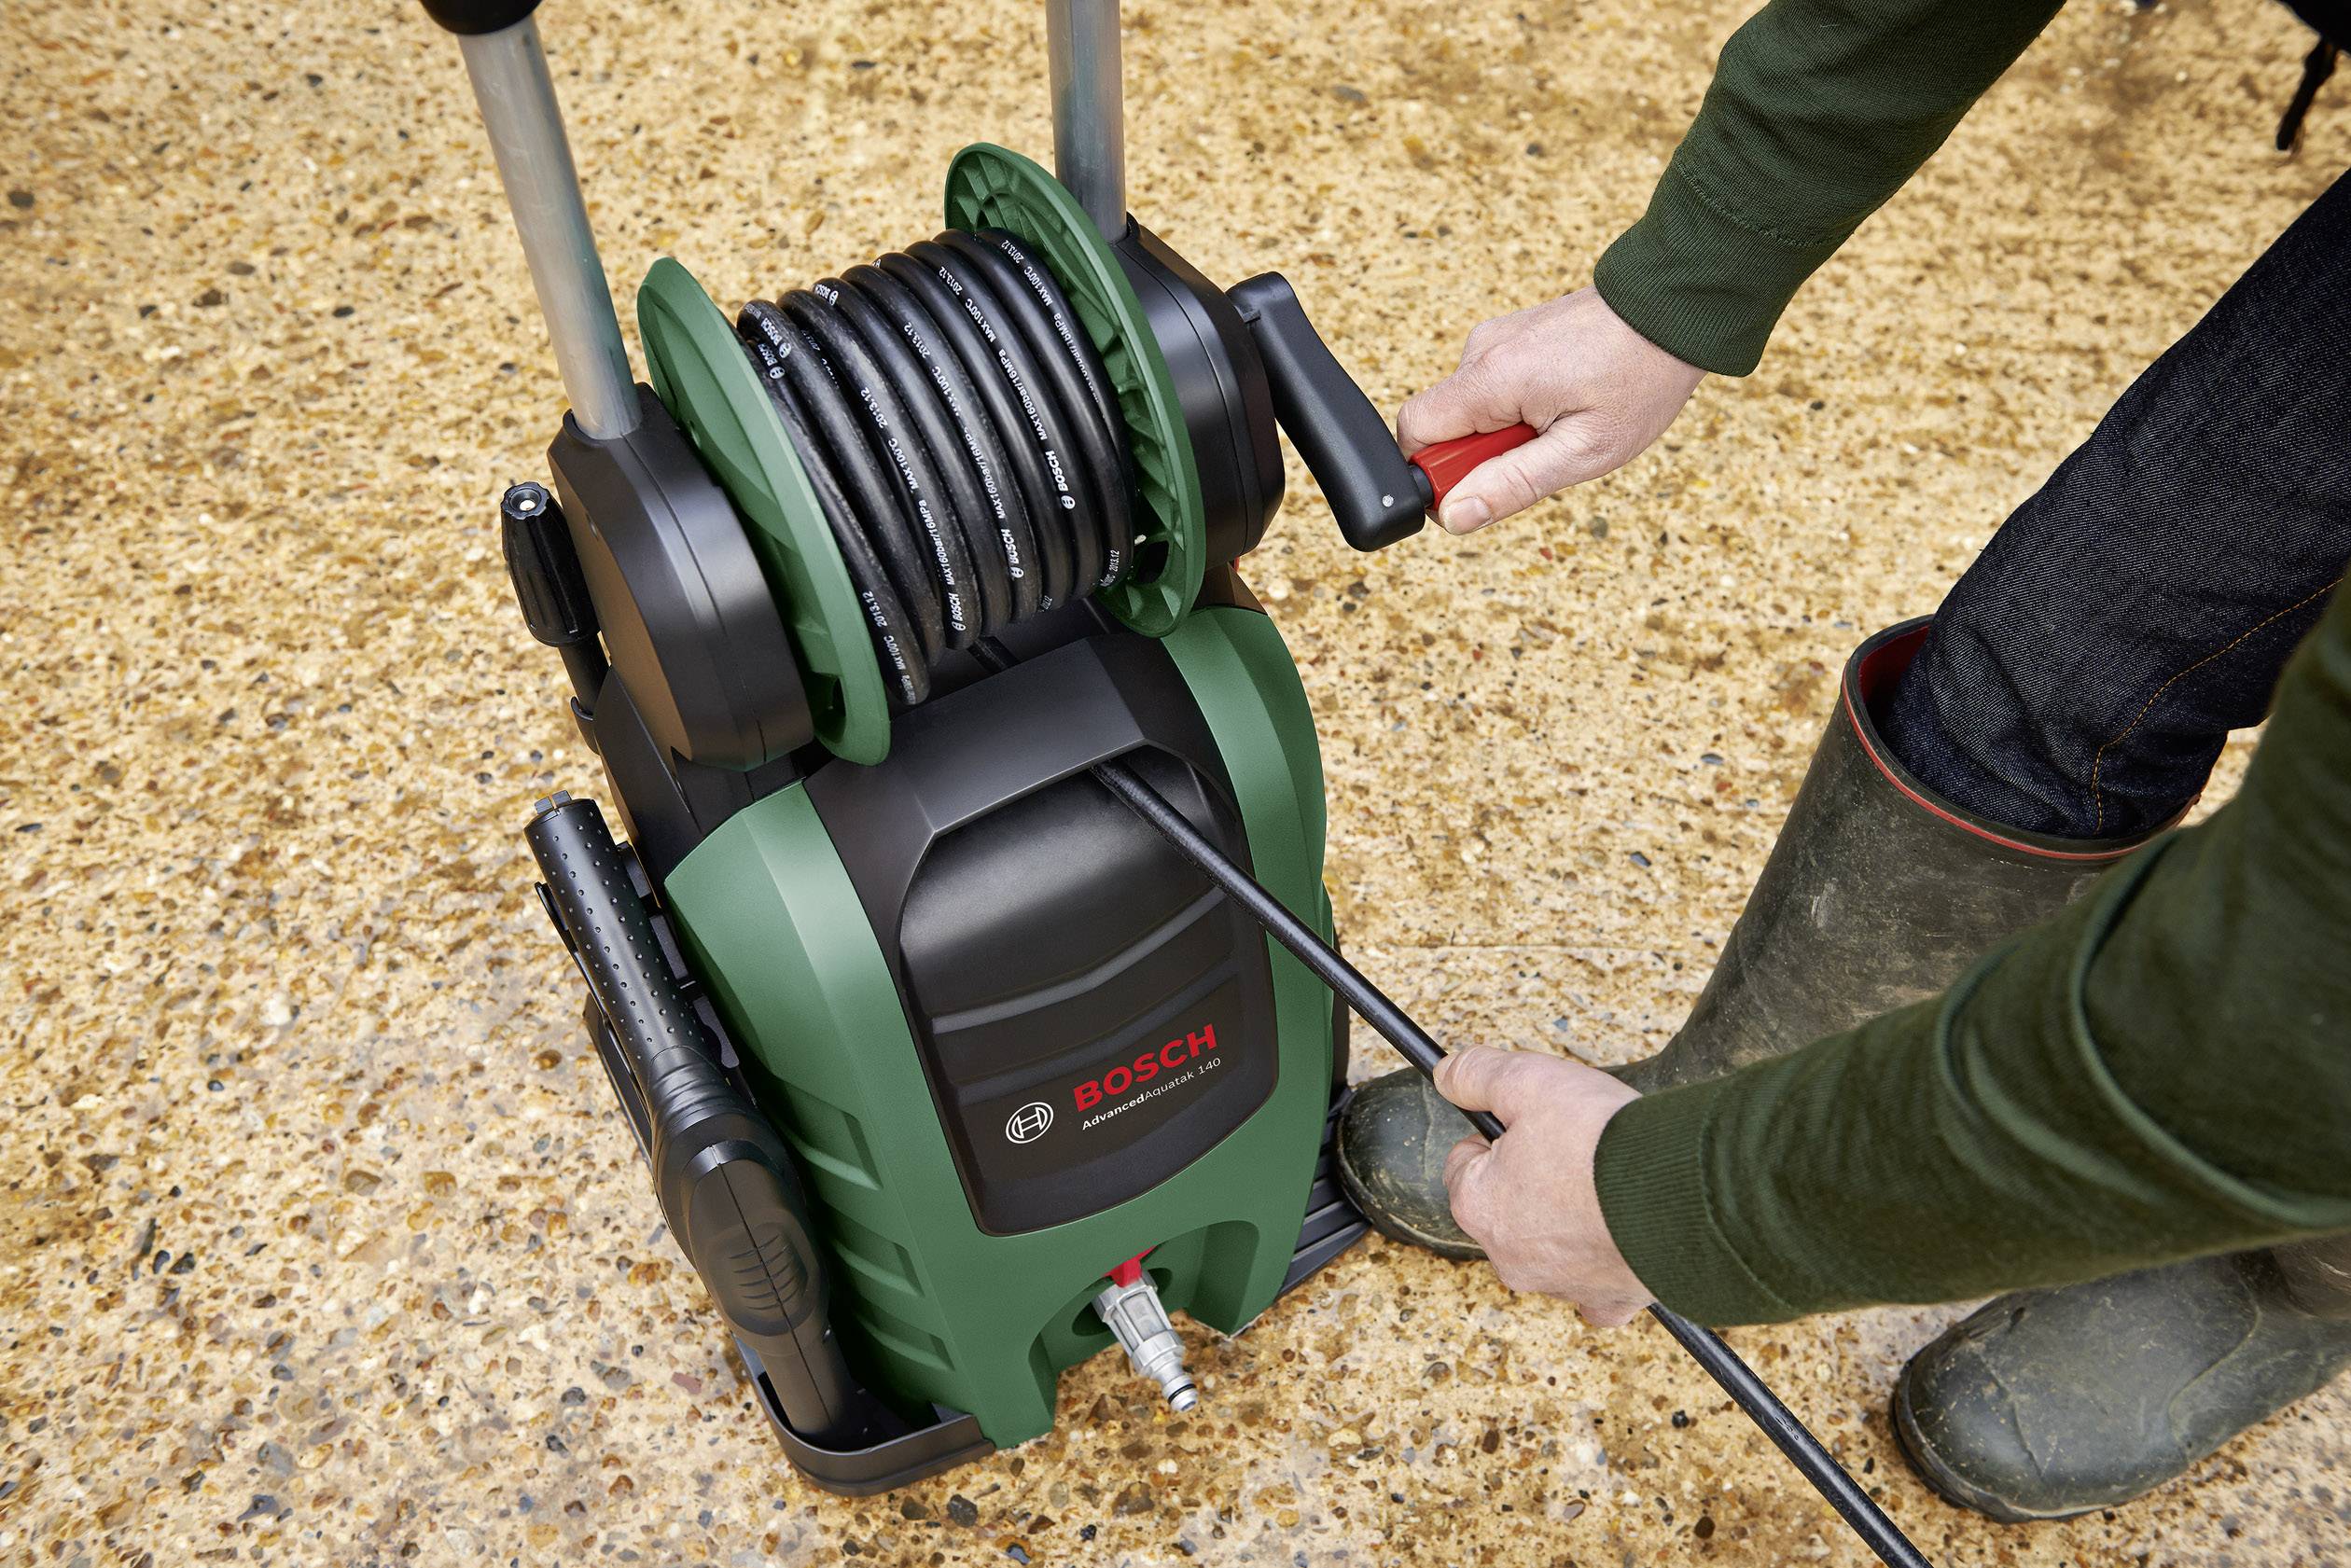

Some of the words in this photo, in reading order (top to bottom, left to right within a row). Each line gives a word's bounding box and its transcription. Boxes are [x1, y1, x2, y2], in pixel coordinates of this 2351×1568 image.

[1001, 239, 1024, 264] 2013.12
[939, 266, 963, 296] 2013.12
[761, 318, 783, 346] BOSCH
[903, 322, 930, 359] 2013.12
[860, 387, 888, 428] 2013.12
[998, 349, 1048, 441] MAX160bar/16MPa
[1045, 451, 1069, 492] BOSCH
[918, 499, 955, 585] MAX160bar/16MPa
[1000, 528, 1020, 564] BOSCH
[1109, 549, 1120, 572] 2013.12
[862, 590, 888, 627] 2013.12
[948, 592, 965, 621] BOSCH
[1073, 1023, 1217, 1112] BOSCH
[1082, 1071, 1194, 1131] AdvancedAquatak
[1198, 1057, 1221, 1075] 140
